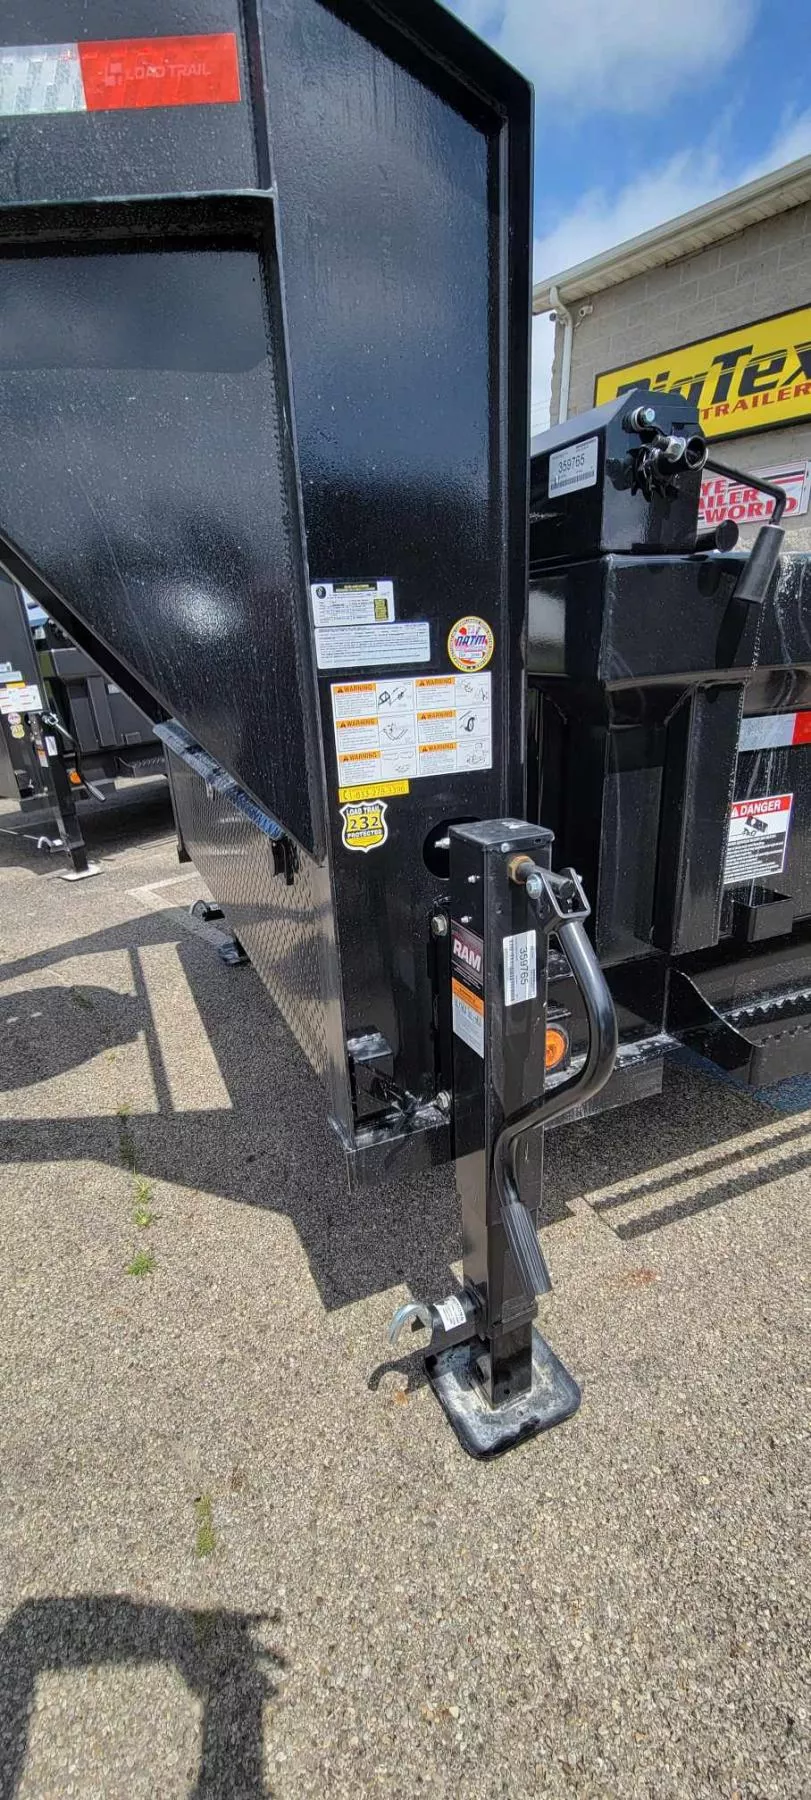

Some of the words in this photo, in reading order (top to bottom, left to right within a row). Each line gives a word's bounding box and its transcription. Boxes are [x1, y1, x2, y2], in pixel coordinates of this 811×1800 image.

[126, 65, 165, 80] LOAD
[167, 62, 211, 78] TRAIL
[558, 453, 585, 474] 359765
[425, 678, 452, 686] WARNING
[343, 684, 373, 693] WARNING
[427, 711, 453, 719] WARNING
[346, 719, 375, 728] WARNING
[429, 743, 454, 751] WARNING
[349, 752, 378, 760] WARNING
[346, 807, 362, 815] LOAD
[363, 805, 380, 814] TRAIL
[740, 799, 781, 816] DANGER
[350, 816, 379, 830] 232
[453, 939, 481, 972] RAM
[519, 946, 529, 986] 359765
